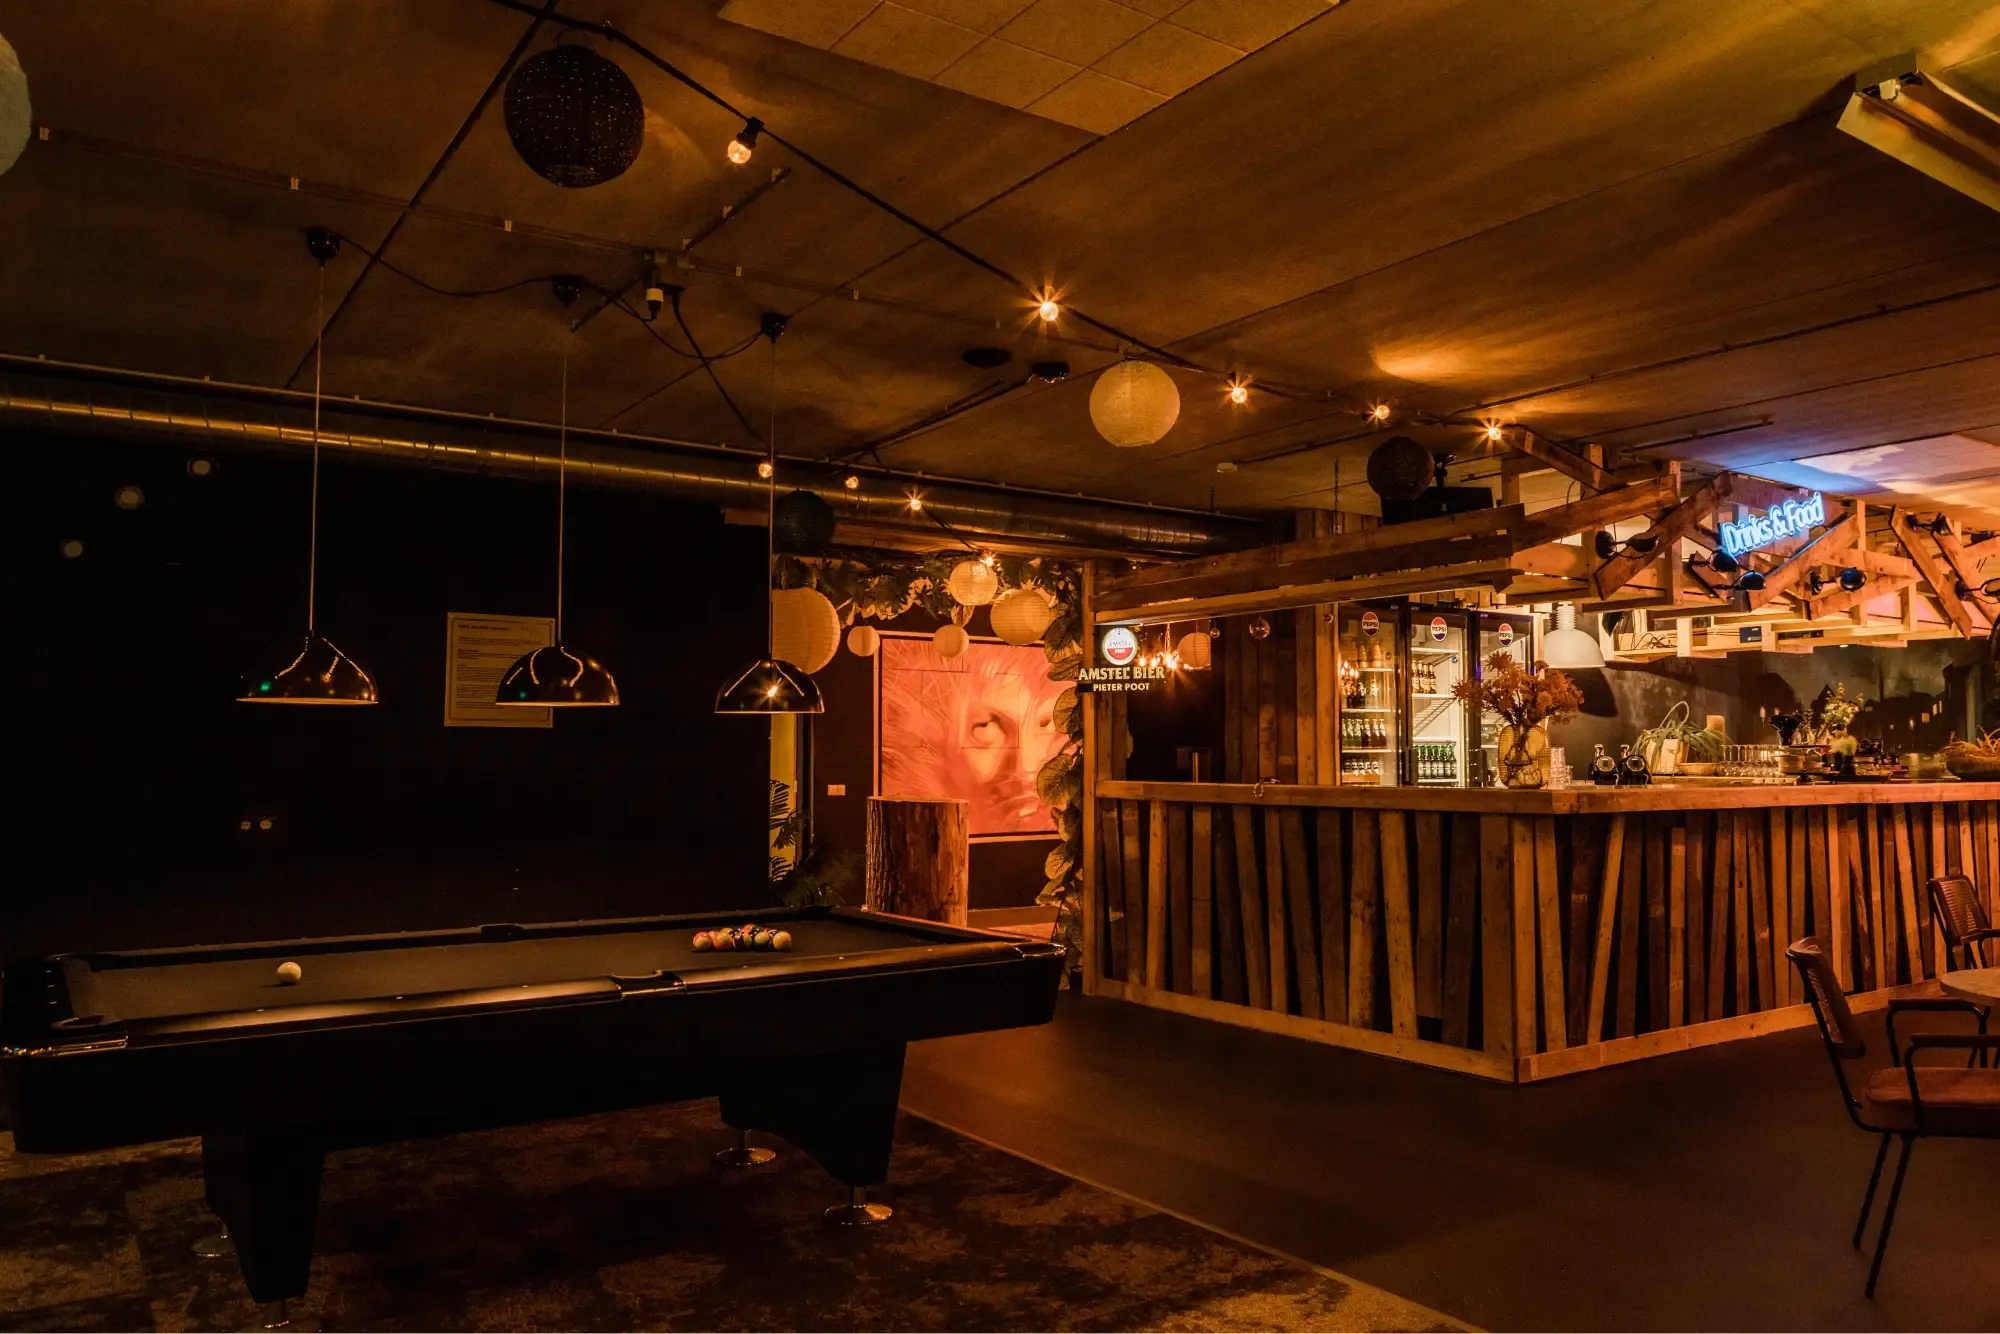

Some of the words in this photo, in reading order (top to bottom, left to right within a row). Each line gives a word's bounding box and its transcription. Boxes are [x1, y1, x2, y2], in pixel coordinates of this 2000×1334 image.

[1725, 515, 1774, 554] Drinks
[1772, 506, 1788, 539] &
[1785, 494, 1824, 533] Food
[1362, 620, 1379, 628] PEPSI
[1079, 667, 1130, 680] AMSTEL
[1133, 667, 1165, 679] BIER
[1093, 683, 1123, 692] PIETER
[1125, 683, 1150, 691] POOT
